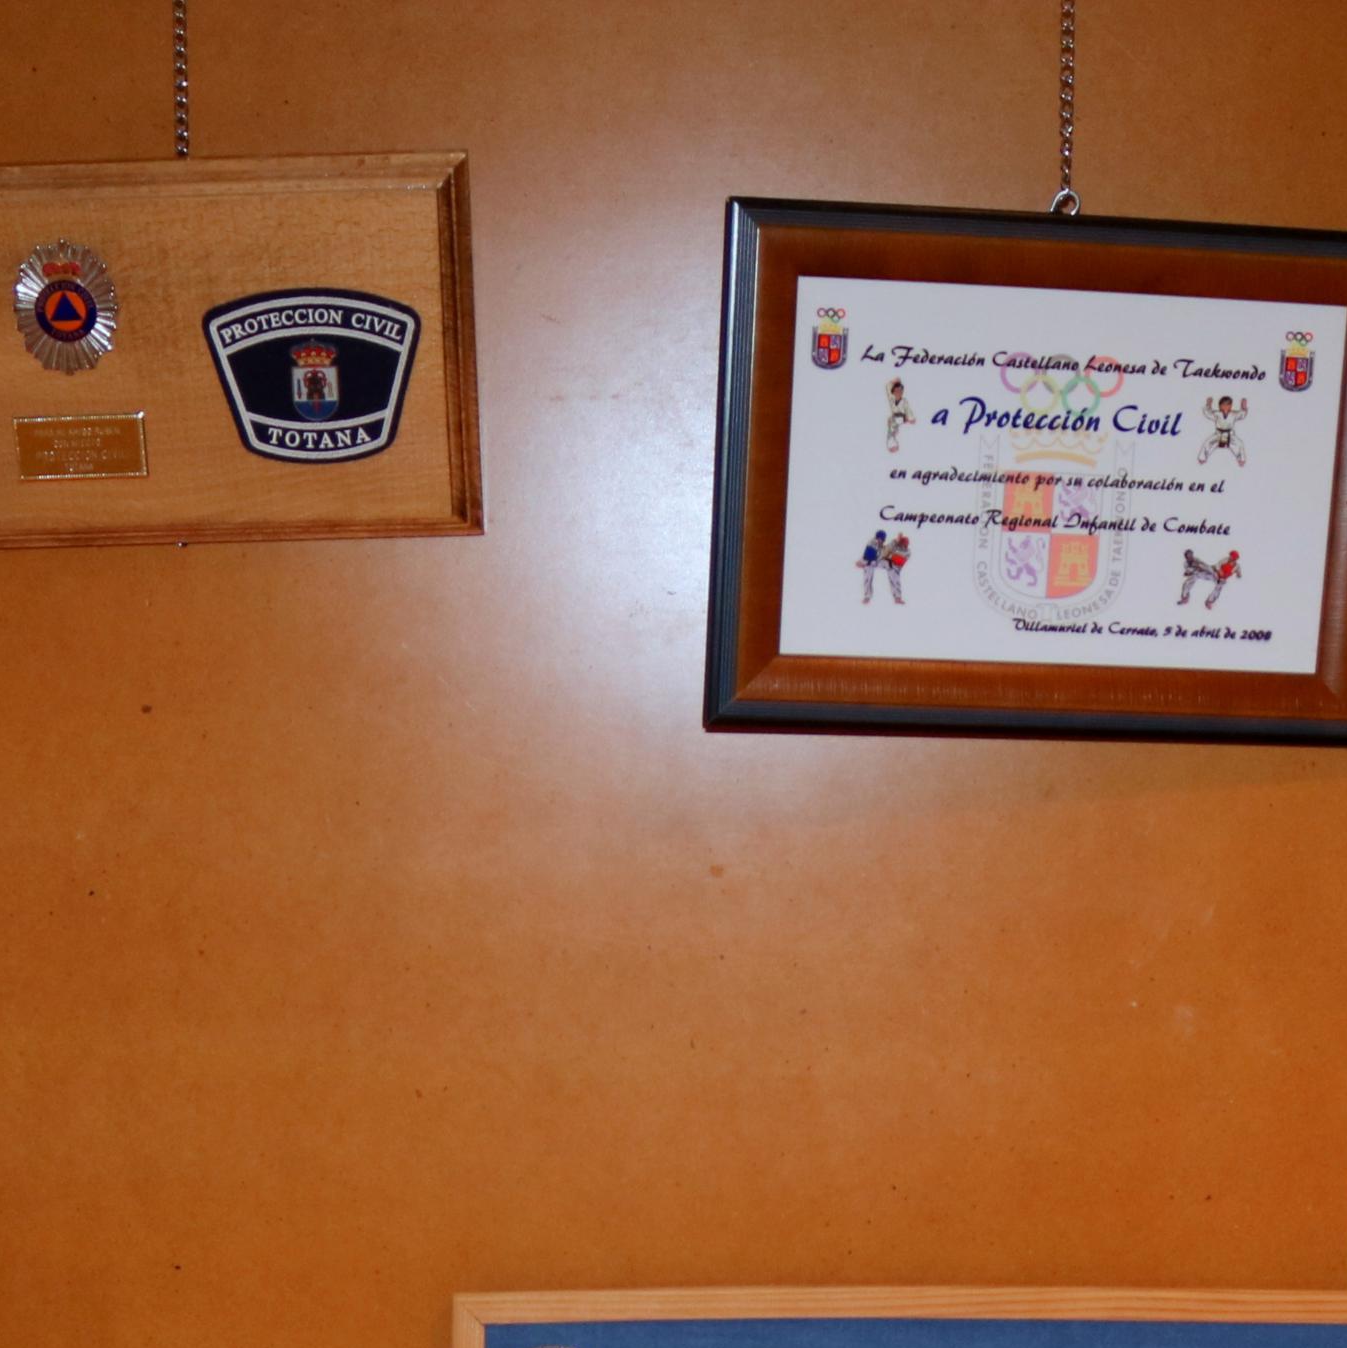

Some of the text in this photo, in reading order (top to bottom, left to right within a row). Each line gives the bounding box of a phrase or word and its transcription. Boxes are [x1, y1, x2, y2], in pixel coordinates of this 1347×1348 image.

[220, 308, 402, 344] PROTECCION CIVIL
[861, 344, 1267, 381] La Federación Castellano Leonesa de Taekwondo
[931, 396, 1183, 436] a Protección Civil
[268, 427, 371, 449] TOTANA
[889, 466, 1225, 493] en agradecimiento por su colaboración en el
[879, 505, 1231, 535] Campeonato Regional Infantil de Combate
[1012, 617, 1086, 634] Villamuriel
[1090, 621, 1103, 634] de
[1174, 625, 1187, 638] de
[1191, 625, 1220, 639] abril
[1223, 627, 1236, 640] de
